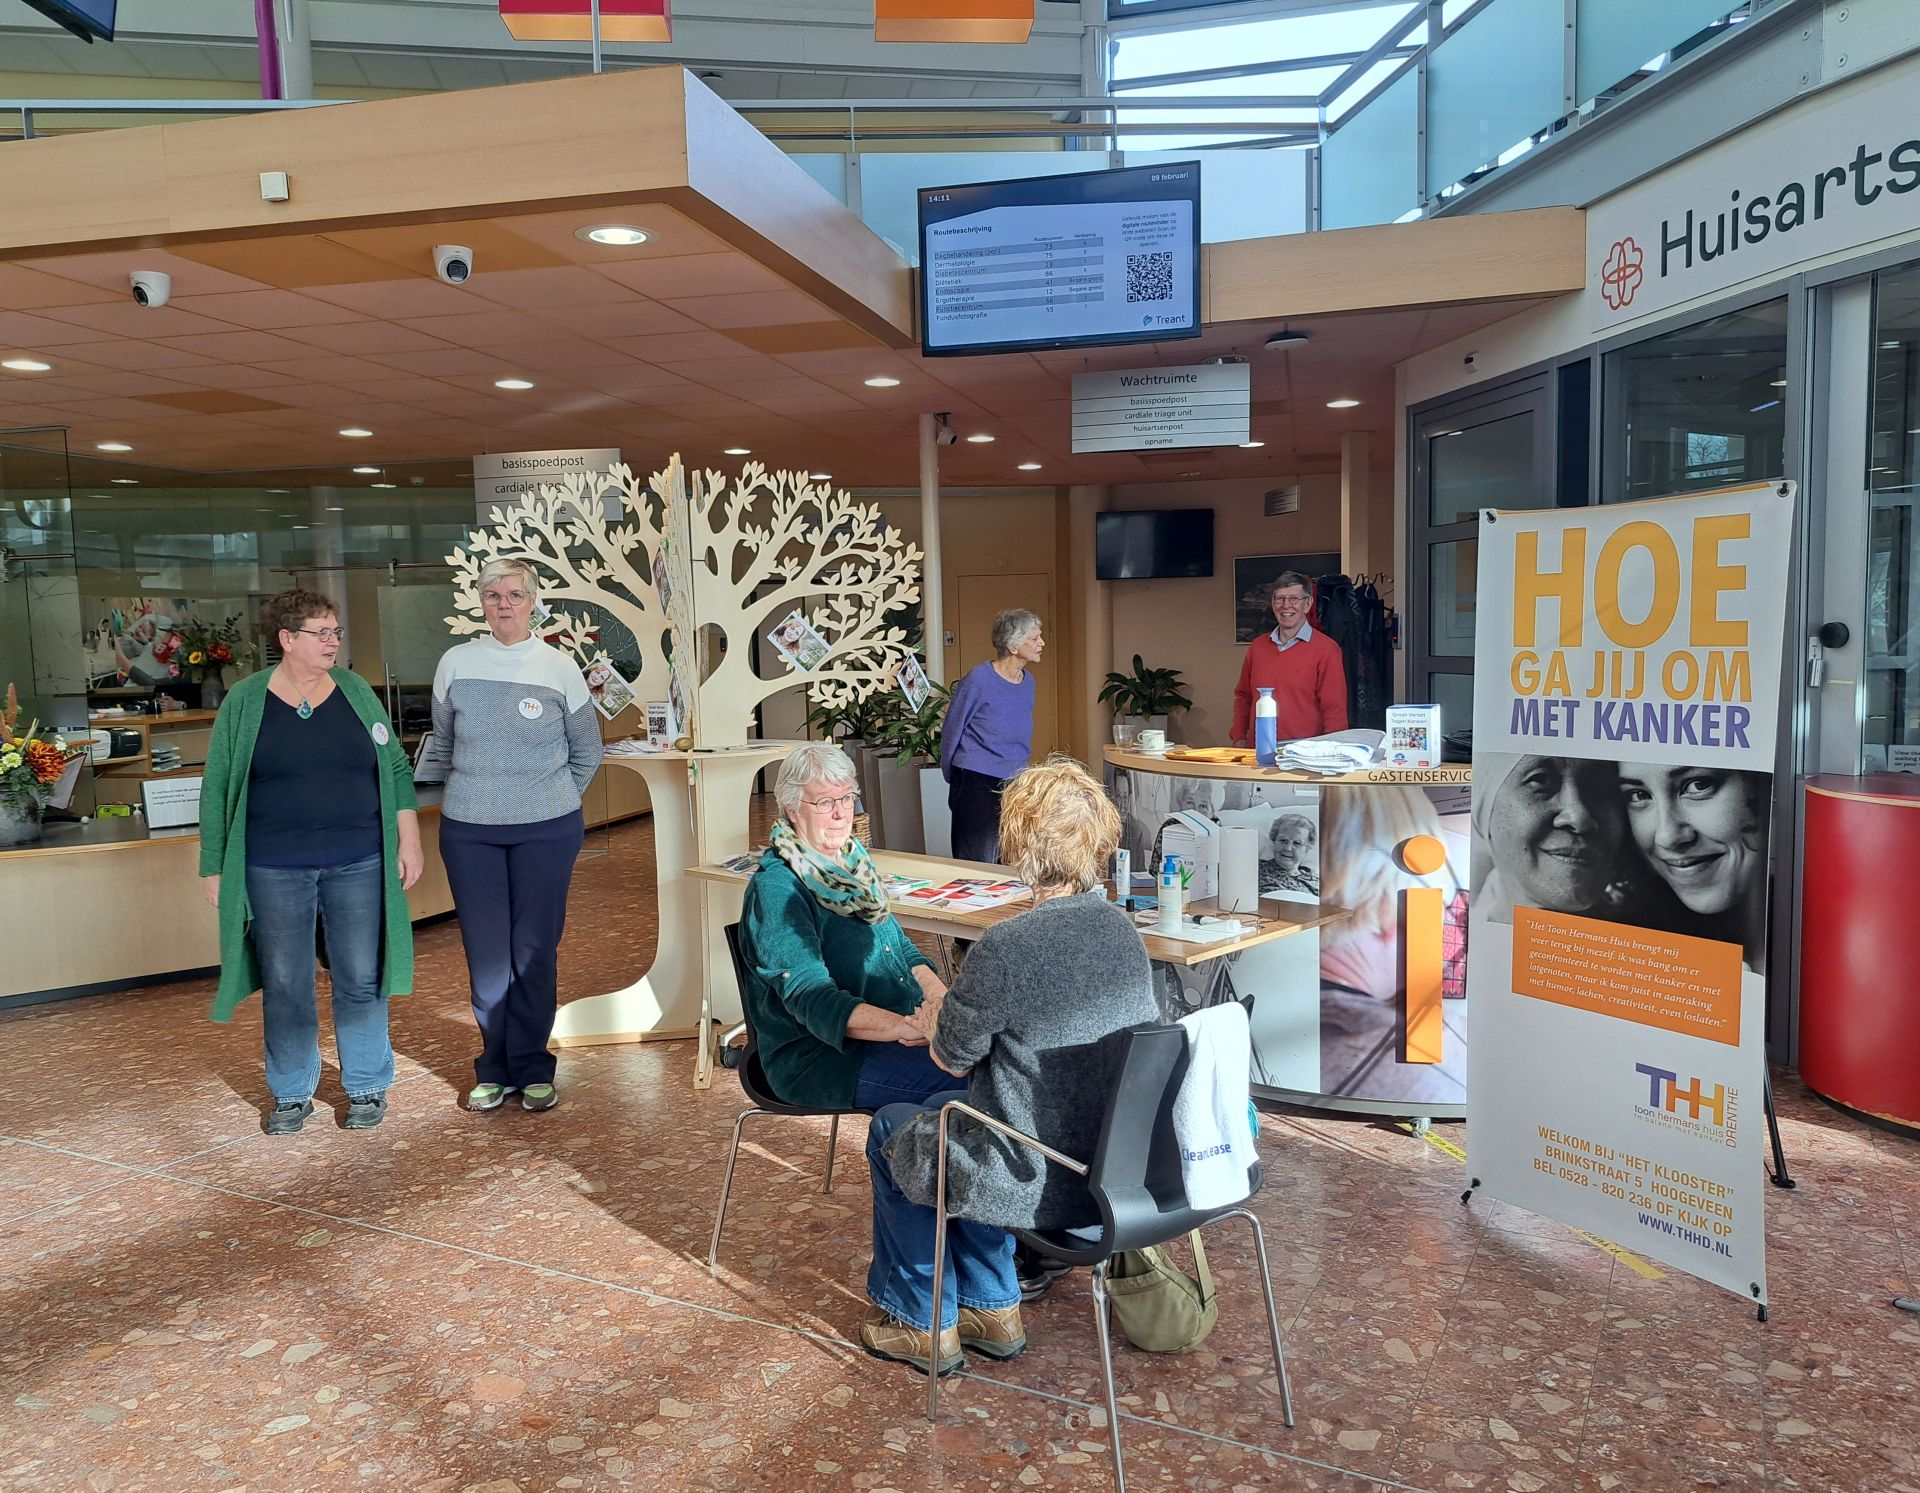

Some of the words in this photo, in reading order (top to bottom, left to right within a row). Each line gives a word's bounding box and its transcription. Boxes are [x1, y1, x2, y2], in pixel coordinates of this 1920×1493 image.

[1151, 174, 1160, 182] 09
[1161, 172, 1189, 181] februari
[928, 194, 951, 203] 14:11
[1660, 140, 1920, 278] Huisarts
[933, 225, 992, 236] Routebeschrijving
[934, 250, 984, 261] Dagbehandeling
[934, 260, 976, 269] Dermatologie
[934, 267, 987, 278] Diabetescentrum
[935, 287, 970, 296] Endoscopie
[935, 296, 975, 305] Ergotherapie
[935, 304, 984, 313] Functiecentrum
[936, 312, 988, 321] Fundusfotografie
[1155, 314, 1186, 325] Treant
[1120, 373, 1198, 387] Wachtruimte
[1130, 396, 1188, 406] basisspoedpost
[1124, 411, 1153, 420] cardiale
[1154, 410, 1176, 418] triage
[1177, 409, 1193, 417] unit
[1133, 423, 1184, 433] huisartsenpost
[1144, 438, 1174, 446] opname
[502, 456, 584, 470] basisspoedpost
[495, 481, 534, 494] cardiale
[1512, 512, 1752, 649] HOE
[1510, 650, 1572, 697] GA
[1585, 650, 1646, 700] JIJ
[1661, 650, 1753, 702] OM
[1510, 698, 1581, 739] MET
[1593, 701, 1751, 749] KANKER
[1368, 770, 1472, 782] GASTENSERVIC
[1547, 924, 1567, 936] Toon
[1569, 928, 1608, 944] Hermans
[1609, 936, 1631, 948] Huis
[1632, 939, 1661, 955] brengt
[1663, 947, 1680, 959] mij
[1530, 936, 1549, 946] weer
[1550, 940, 1572, 953] terug
[1573, 942, 1586, 955] bij
[1617, 950, 1627, 962] ik
[1628, 956, 1646, 967] was
[1648, 957, 1670, 973] bang
[1672, 964, 1687, 975] om
[1689, 967, 1701, 977] er
[1529, 949, 1589, 969] geconfronteerd
[1590, 960, 1599, 970] te
[1600, 963, 1633, 978] worden
[1634, 969, 1652, 981] met
[1653, 973, 1687, 989] kanker
[1688, 981, 1701, 992] en
[1702, 985, 1722, 996] met
[1529, 976, 1544, 987] met
[1545, 979, 1575, 995] humor,
[1576, 987, 1606, 1003] lachen,
[1659, 1007, 1682, 1019] even
[1574, 973, 1598, 985] maar
[1599, 976, 1608, 987] ik
[1609, 978, 1629, 992] kom
[1629, 983, 1651, 998] juist
[1652, 989, 1662, 999] in
[1663, 992, 1713, 1013] aanraking
[1635, 1062, 1725, 1127] THH
[1634, 1104, 1655, 1117] toon
[1657, 1111, 1700, 1131] hermans
[1702, 1124, 1724, 1138] huis
[1725, 1086, 1739, 1149] DRENTHE
[1675, 1126, 1691, 1135] met
[1693, 1131, 1724, 1145] kanker
[1538, 1125, 1591, 1154] WELKOM
[1595, 1143, 1615, 1161] BIJ
[1619, 1152, 1650, 1173] “HET
[1654, 1164, 1735, 1199] KLOOSTER”
[1545, 1145, 1631, 1184] BRINKSTRAAT
[1634, 1175, 1643, 1188] 5
[1651, 1180, 1734, 1221] HOOGEVEEN
[1533, 1157, 1556, 1176] BEL
[1559, 1167, 1589, 1187] 0528
[1602, 1182, 1625, 1200] 820
[1629, 1191, 1651, 1209] 236
[1656, 1200, 1673, 1217] OF
[1678, 1208, 1709, 1231] KIJK
[1713, 1220, 1732, 1238] OP
[1638, 1211, 1734, 1258] WWW.THHD.NL
